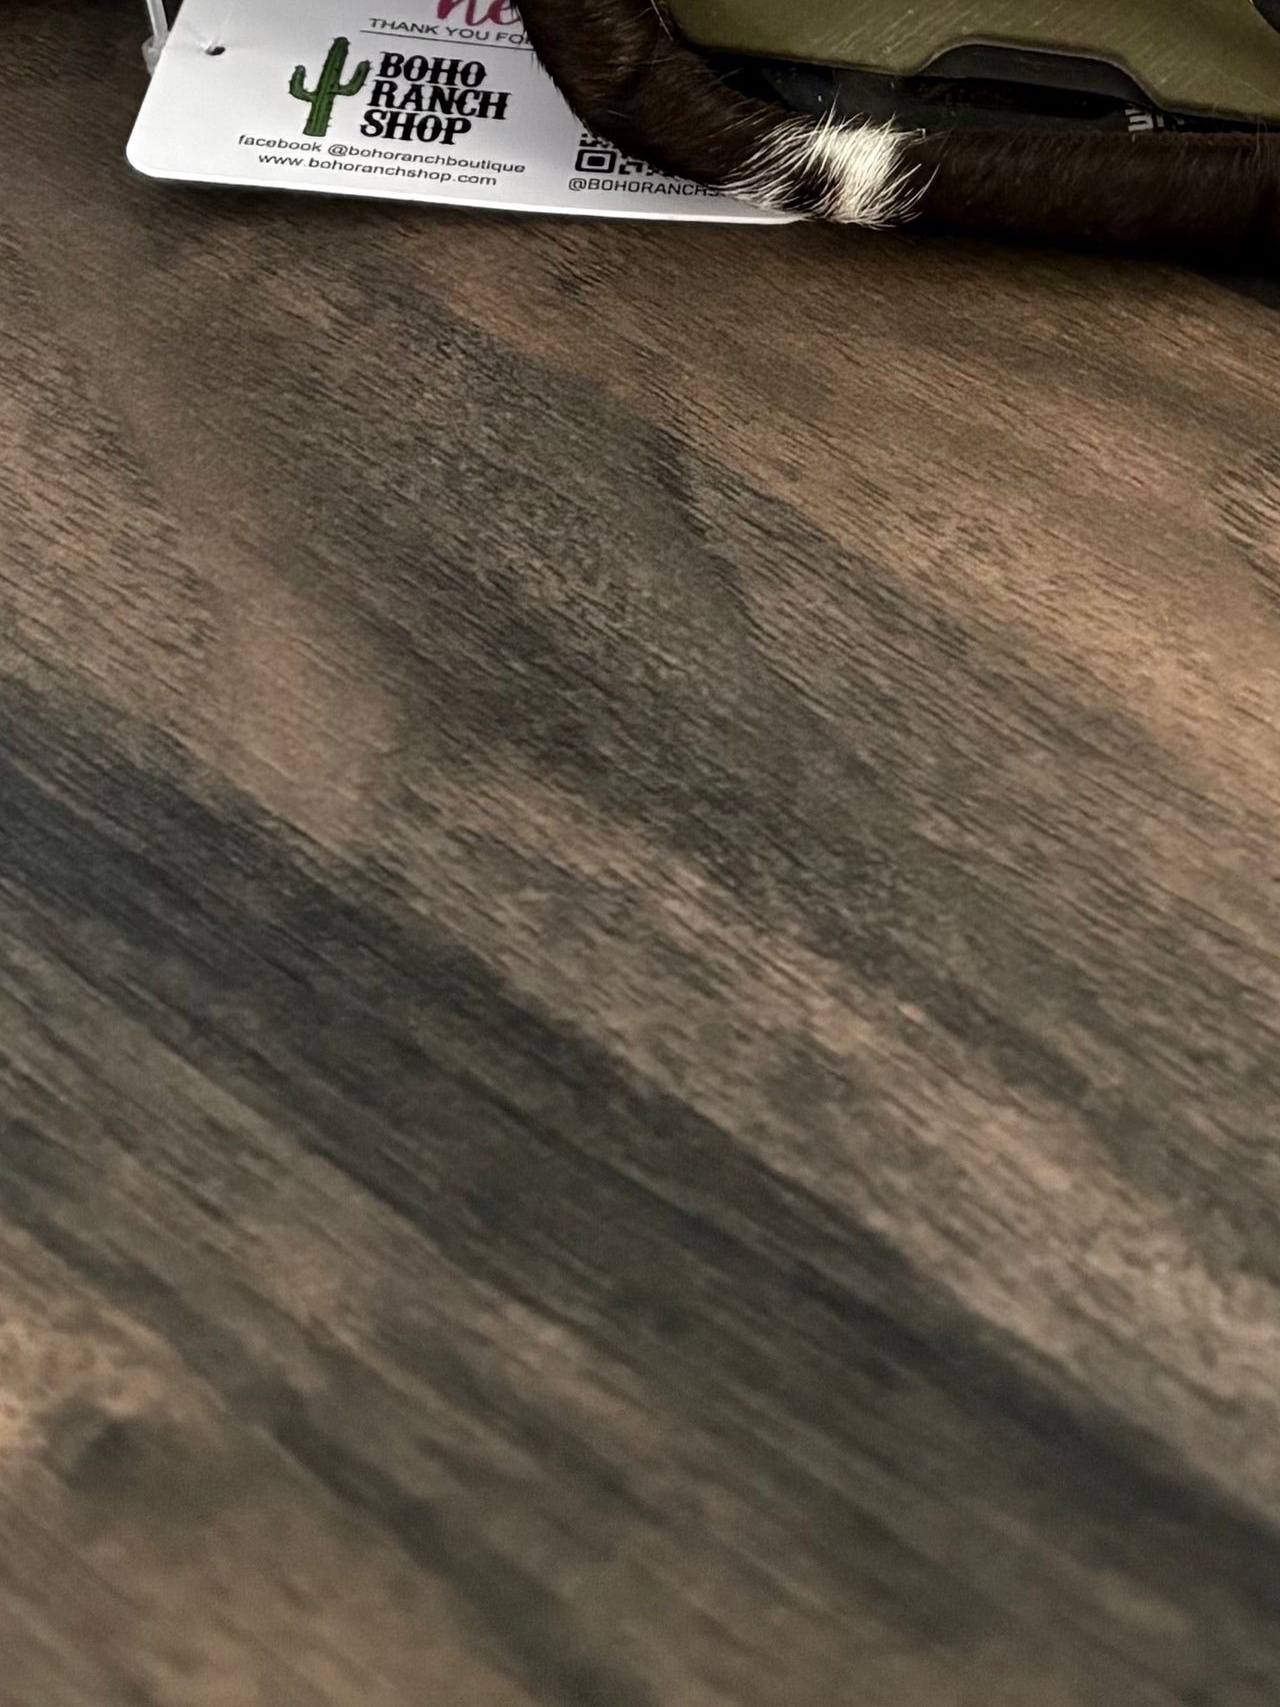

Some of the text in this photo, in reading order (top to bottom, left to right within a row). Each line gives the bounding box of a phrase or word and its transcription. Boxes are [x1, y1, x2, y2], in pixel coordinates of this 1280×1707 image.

[369, 17, 529, 45] THANK YOU FO
[375, 51, 488, 88] BOHO
[366, 79, 513, 120] RANCH
[359, 108, 472, 146] SHOP
[238, 134, 527, 174] facebook @bohoranchboutique
[258, 153, 498, 187] www.bohoranchshop.com
